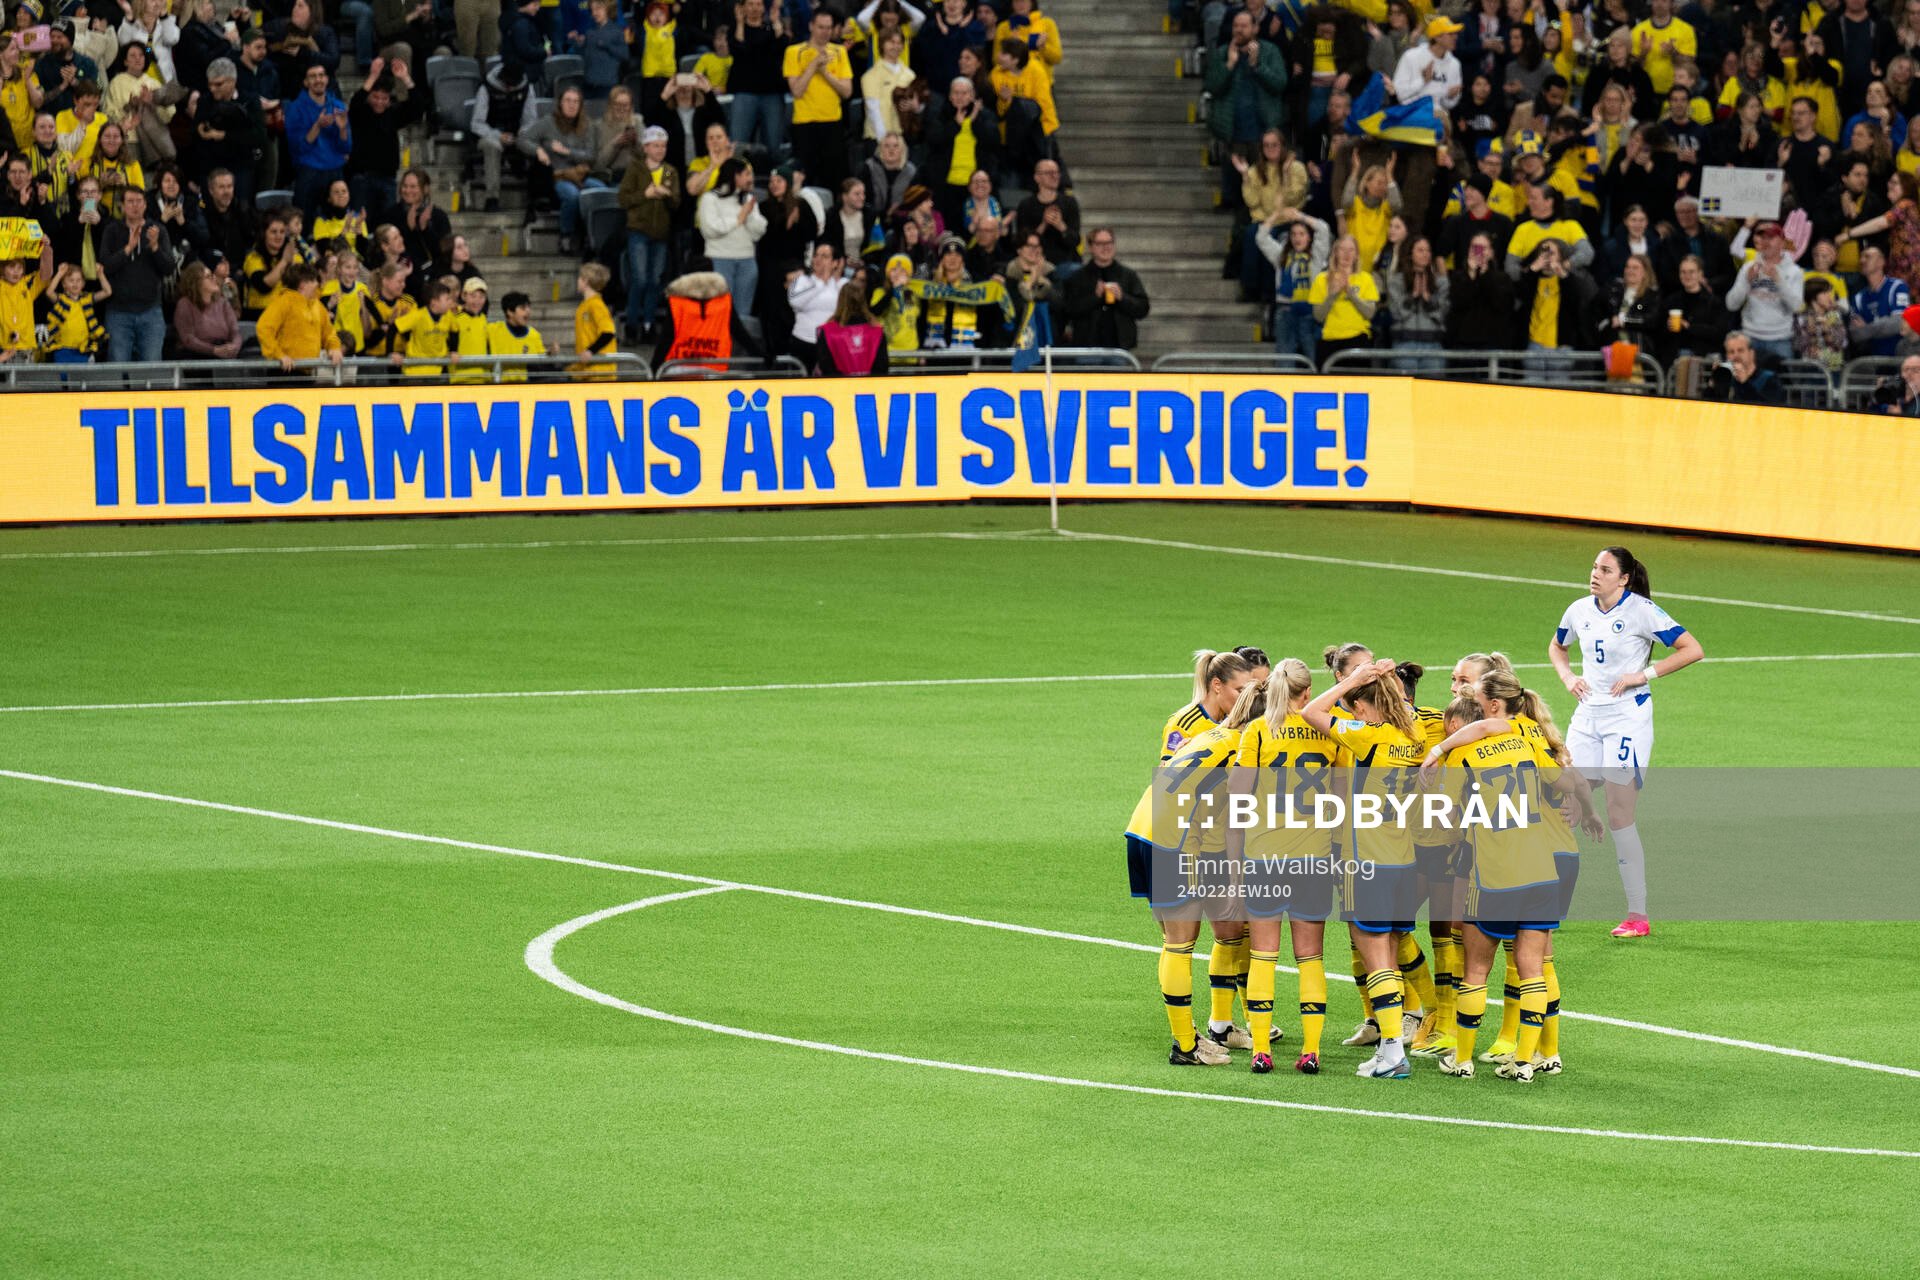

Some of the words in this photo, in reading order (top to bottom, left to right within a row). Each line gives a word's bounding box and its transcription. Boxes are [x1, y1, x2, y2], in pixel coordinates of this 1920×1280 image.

[80, 396, 701, 506] TILLSAMMANS
[721, 388, 835, 492] ÄR
[854, 392, 937, 489] VI
[960, 387, 1369, 489] SVERIGE!
[1595, 639, 1605, 664] 5
[1618, 736, 1632, 761] 5
[1268, 751, 1330, 815] 18
[1480, 760, 1542, 833] 20
